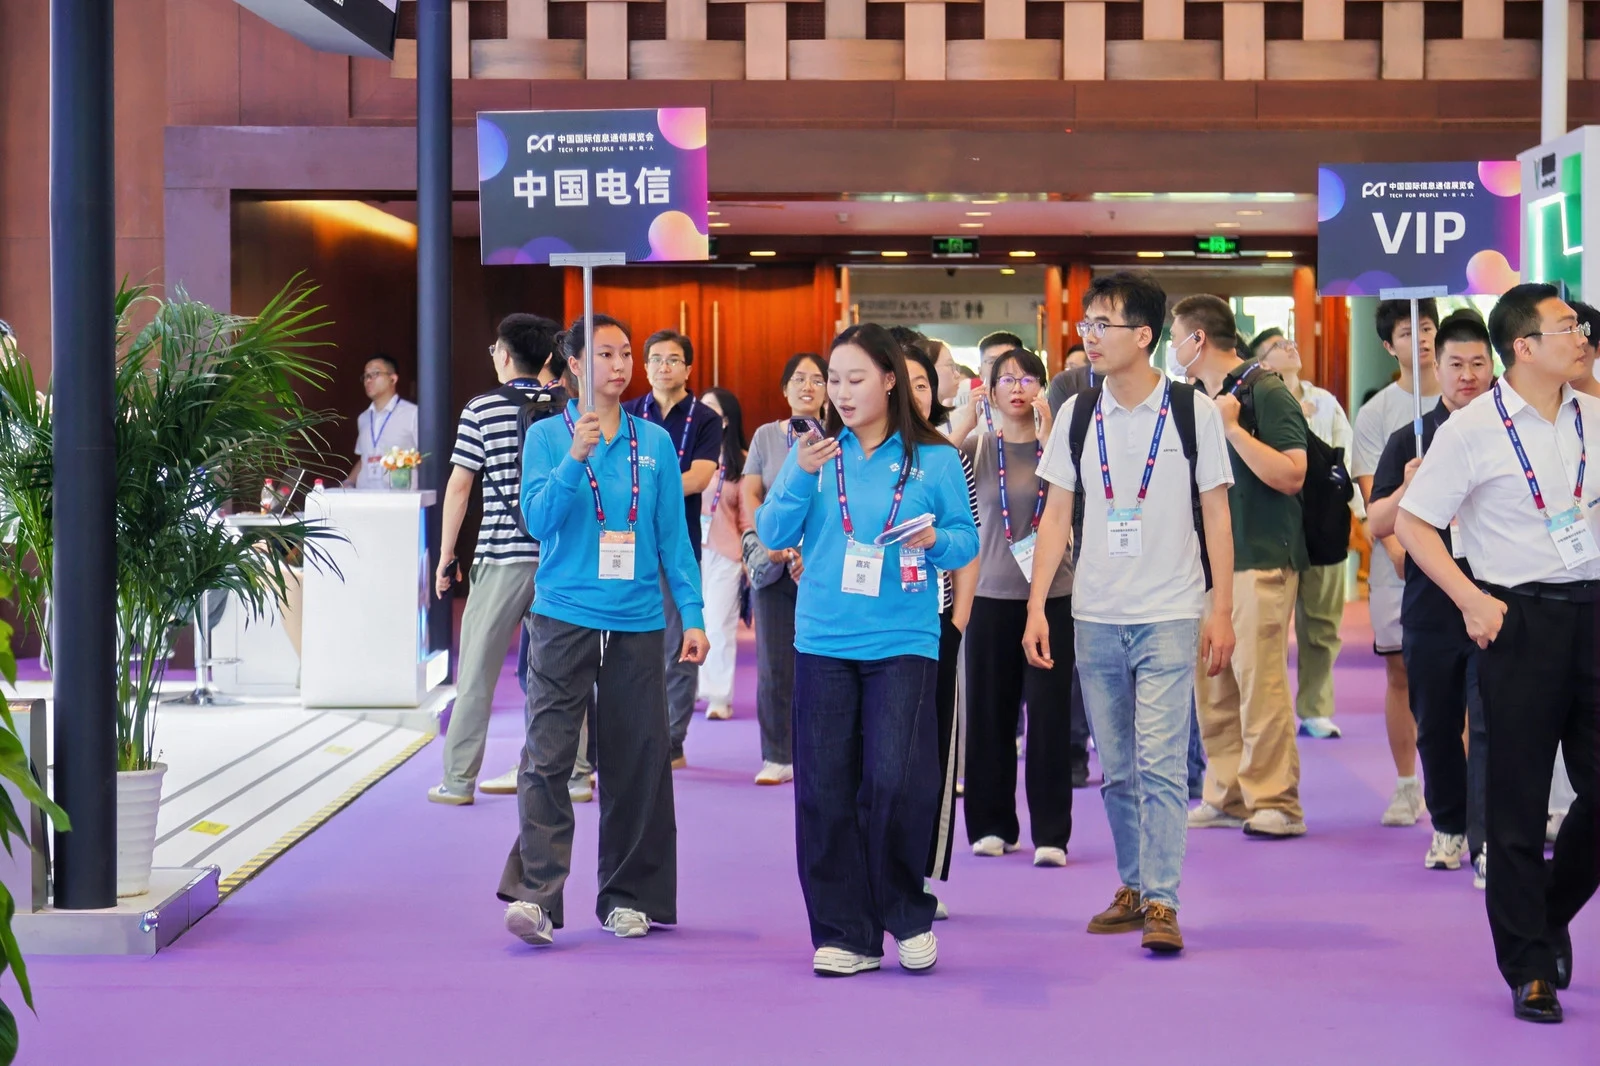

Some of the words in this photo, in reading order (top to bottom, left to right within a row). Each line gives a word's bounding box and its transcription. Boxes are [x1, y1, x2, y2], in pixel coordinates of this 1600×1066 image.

[557, 132, 655, 144] 中国国际信息通信展览会
[513, 167, 671, 208] 中国电信
[1389, 181, 1475, 190] 中国国际信息通信展览会
[1372, 211, 1466, 254] VIP
